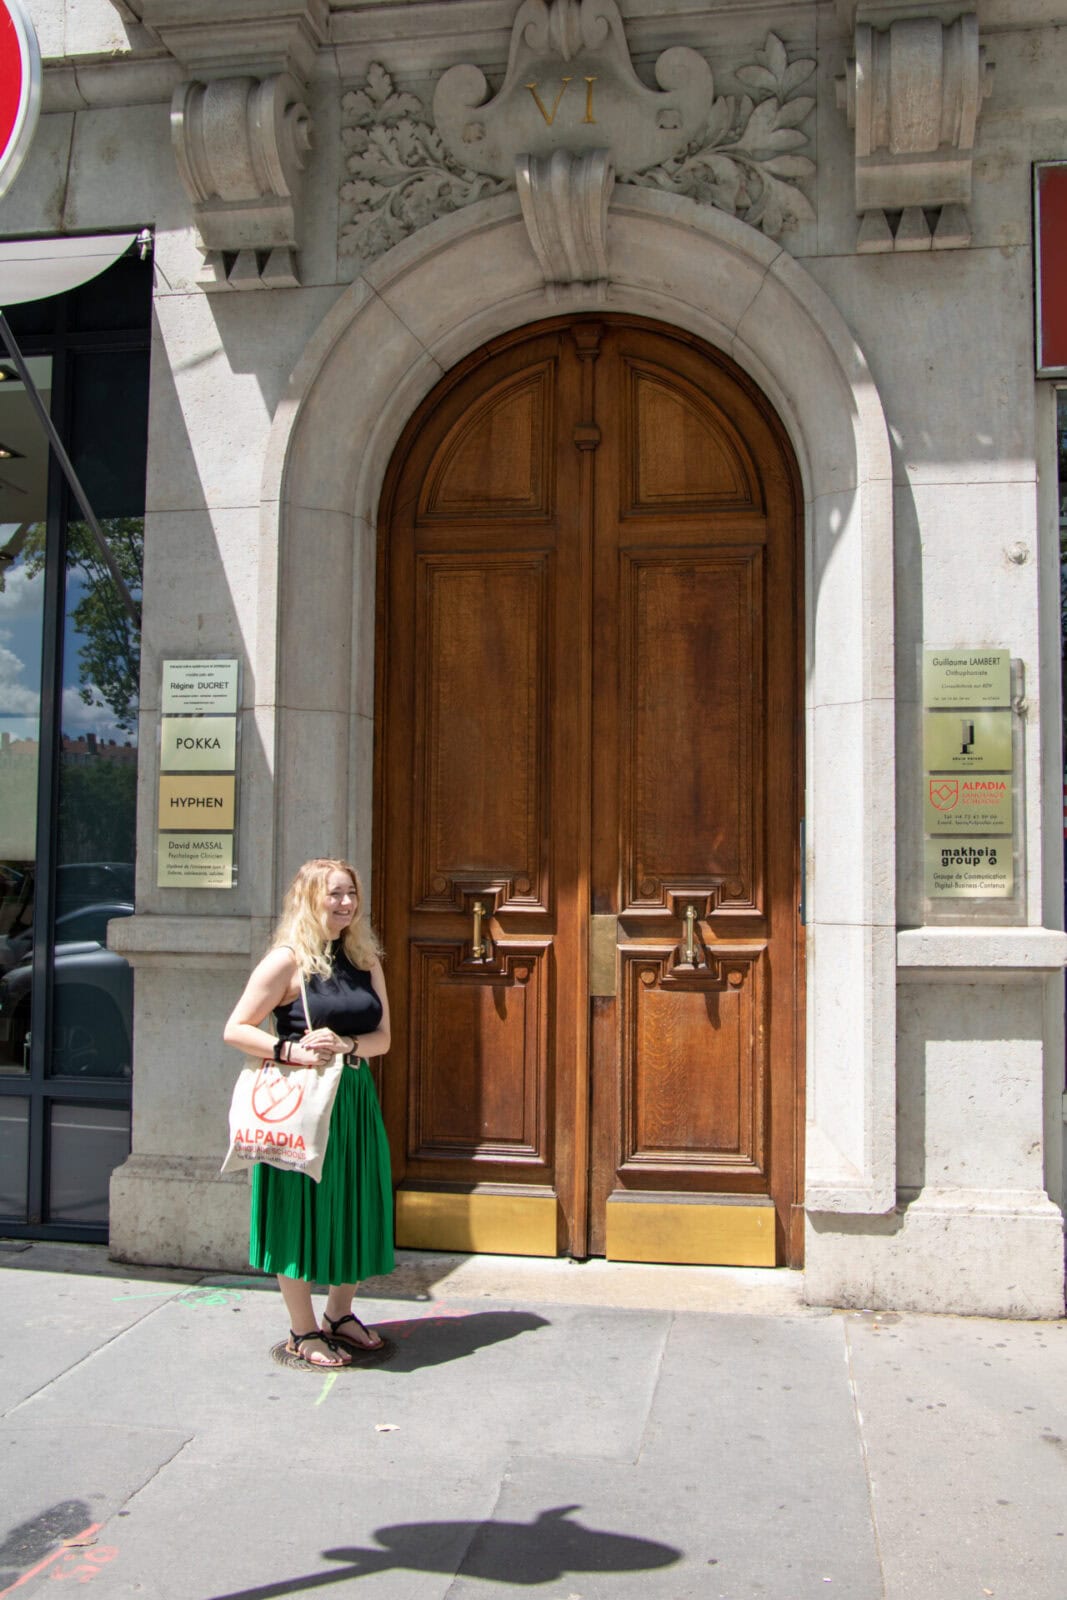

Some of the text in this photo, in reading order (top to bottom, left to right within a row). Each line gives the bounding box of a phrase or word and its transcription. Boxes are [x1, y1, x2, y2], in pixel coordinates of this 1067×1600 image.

[522, 76, 598, 126] VI
[932, 657, 1000, 666] Guillaume LAMBERT
[170, 681, 229, 691] Régine DUCRET
[176, 738, 221, 749] POKKA
[962, 781, 1006, 791] ALPADIA
[170, 797, 223, 808] HYPHEN
[168, 841, 223, 850] David MASSAL
[941, 846, 997, 857] makheia
[941, 857, 980, 867] group
[933, 872, 954, 881] Groupe
[963, 872, 1006, 880] Communication
[233, 1128, 306, 1151] ALPADIA
